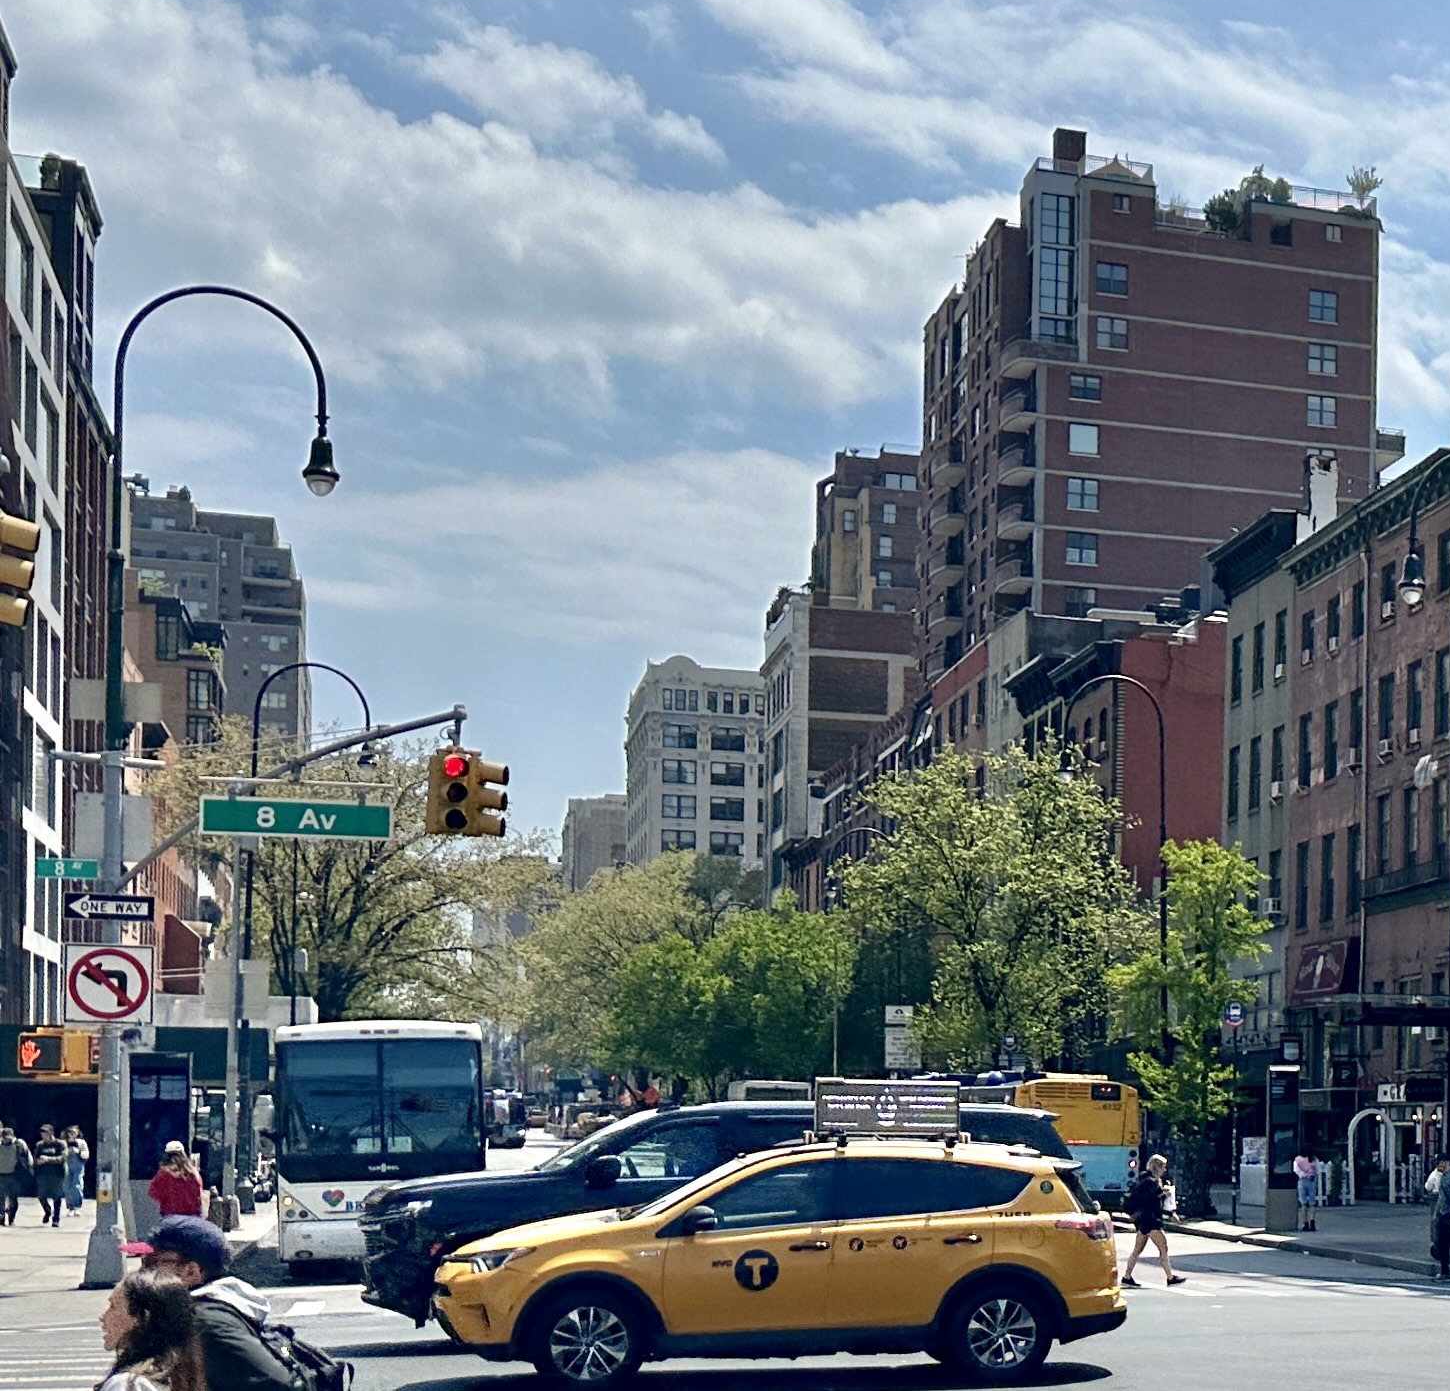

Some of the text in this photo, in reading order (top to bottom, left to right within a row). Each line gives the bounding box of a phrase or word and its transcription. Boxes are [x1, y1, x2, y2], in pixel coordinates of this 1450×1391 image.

[257, 806, 337, 830] 8 Av
[54, 861, 65, 876] 8
[80, 901, 142, 913] ONE WAY
